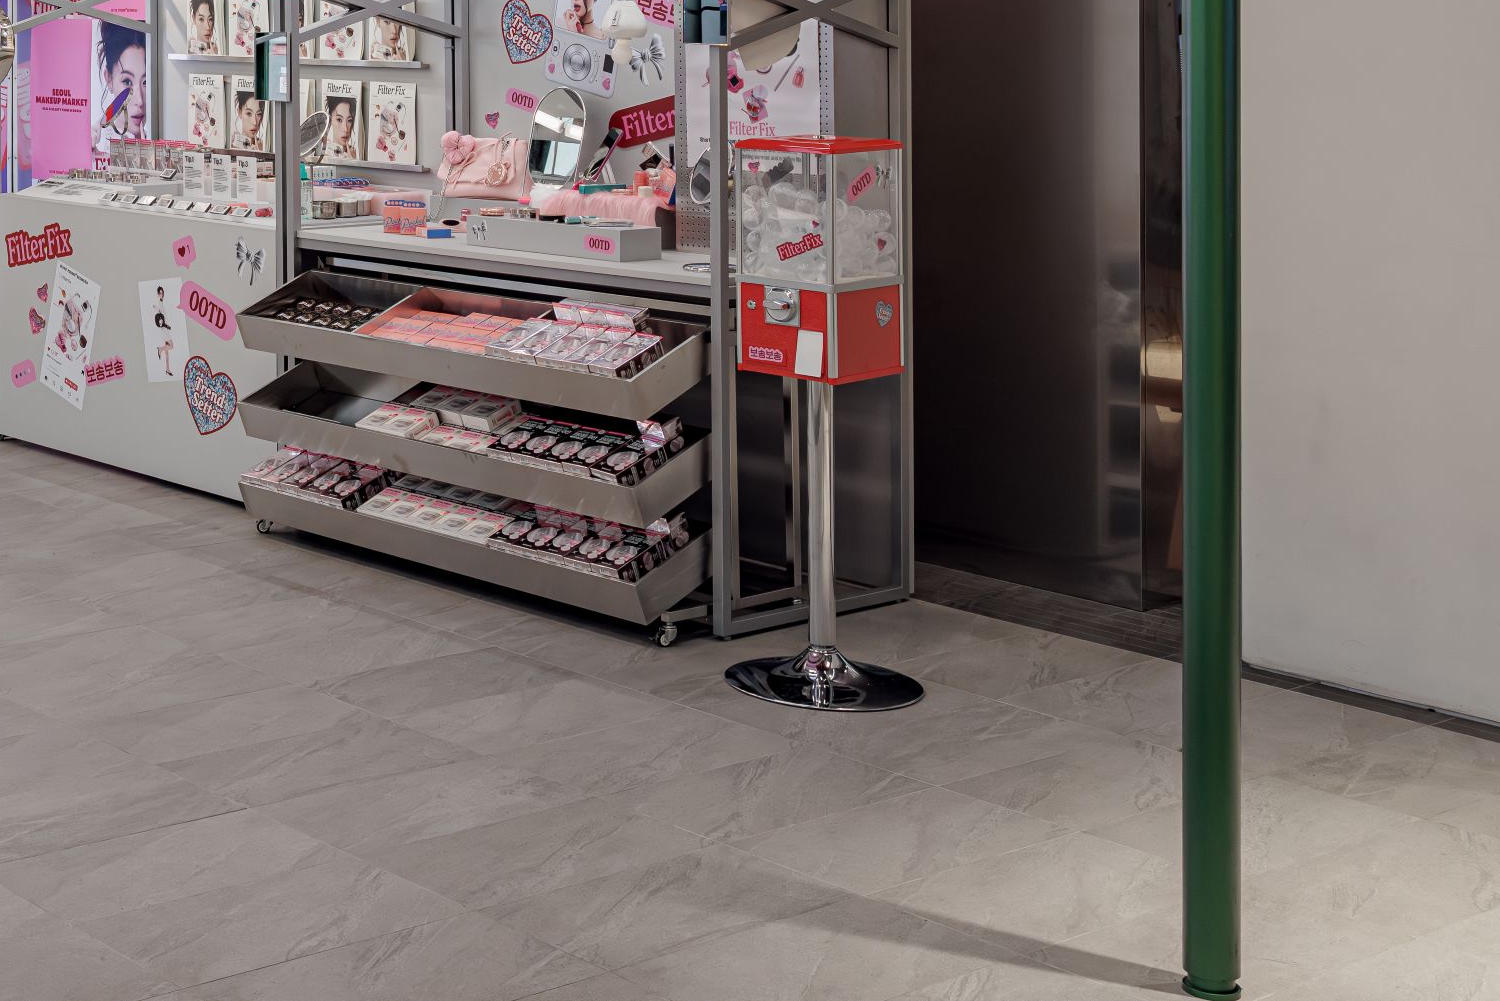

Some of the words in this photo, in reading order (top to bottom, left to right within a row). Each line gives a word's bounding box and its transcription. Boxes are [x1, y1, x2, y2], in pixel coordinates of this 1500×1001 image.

[513, 14, 543, 46] Trend
[506, 27, 538, 56] Setter
[51, 88, 71, 97] SEOUL
[237, 78, 252, 88] Filter
[326, 83, 341, 94] Filter
[341, 83, 352, 94] Fix
[377, 84, 395, 95] Filter
[395, 85, 406, 96] Fix
[35, 95, 62, 105] MAKEUP
[61, 97, 88, 107] MARKET
[511, 91, 534, 109] OOTD
[729, 120, 758, 136] Filter
[759, 121, 776, 137] Fix
[851, 172, 871, 196] OOTD
[7, 233, 47, 264] Filter
[46, 227, 71, 254] Fix
[589, 237, 610, 251] OOTD
[778, 240, 806, 258] Filter
[804, 234, 823, 251] Fix
[189, 290, 227, 330] OOTD
[749, 347, 782, 361] 보송보송
[86, 360, 124, 383] 보송보송
[195, 375, 225, 409] Trend
[192, 392, 223, 424] Setter
